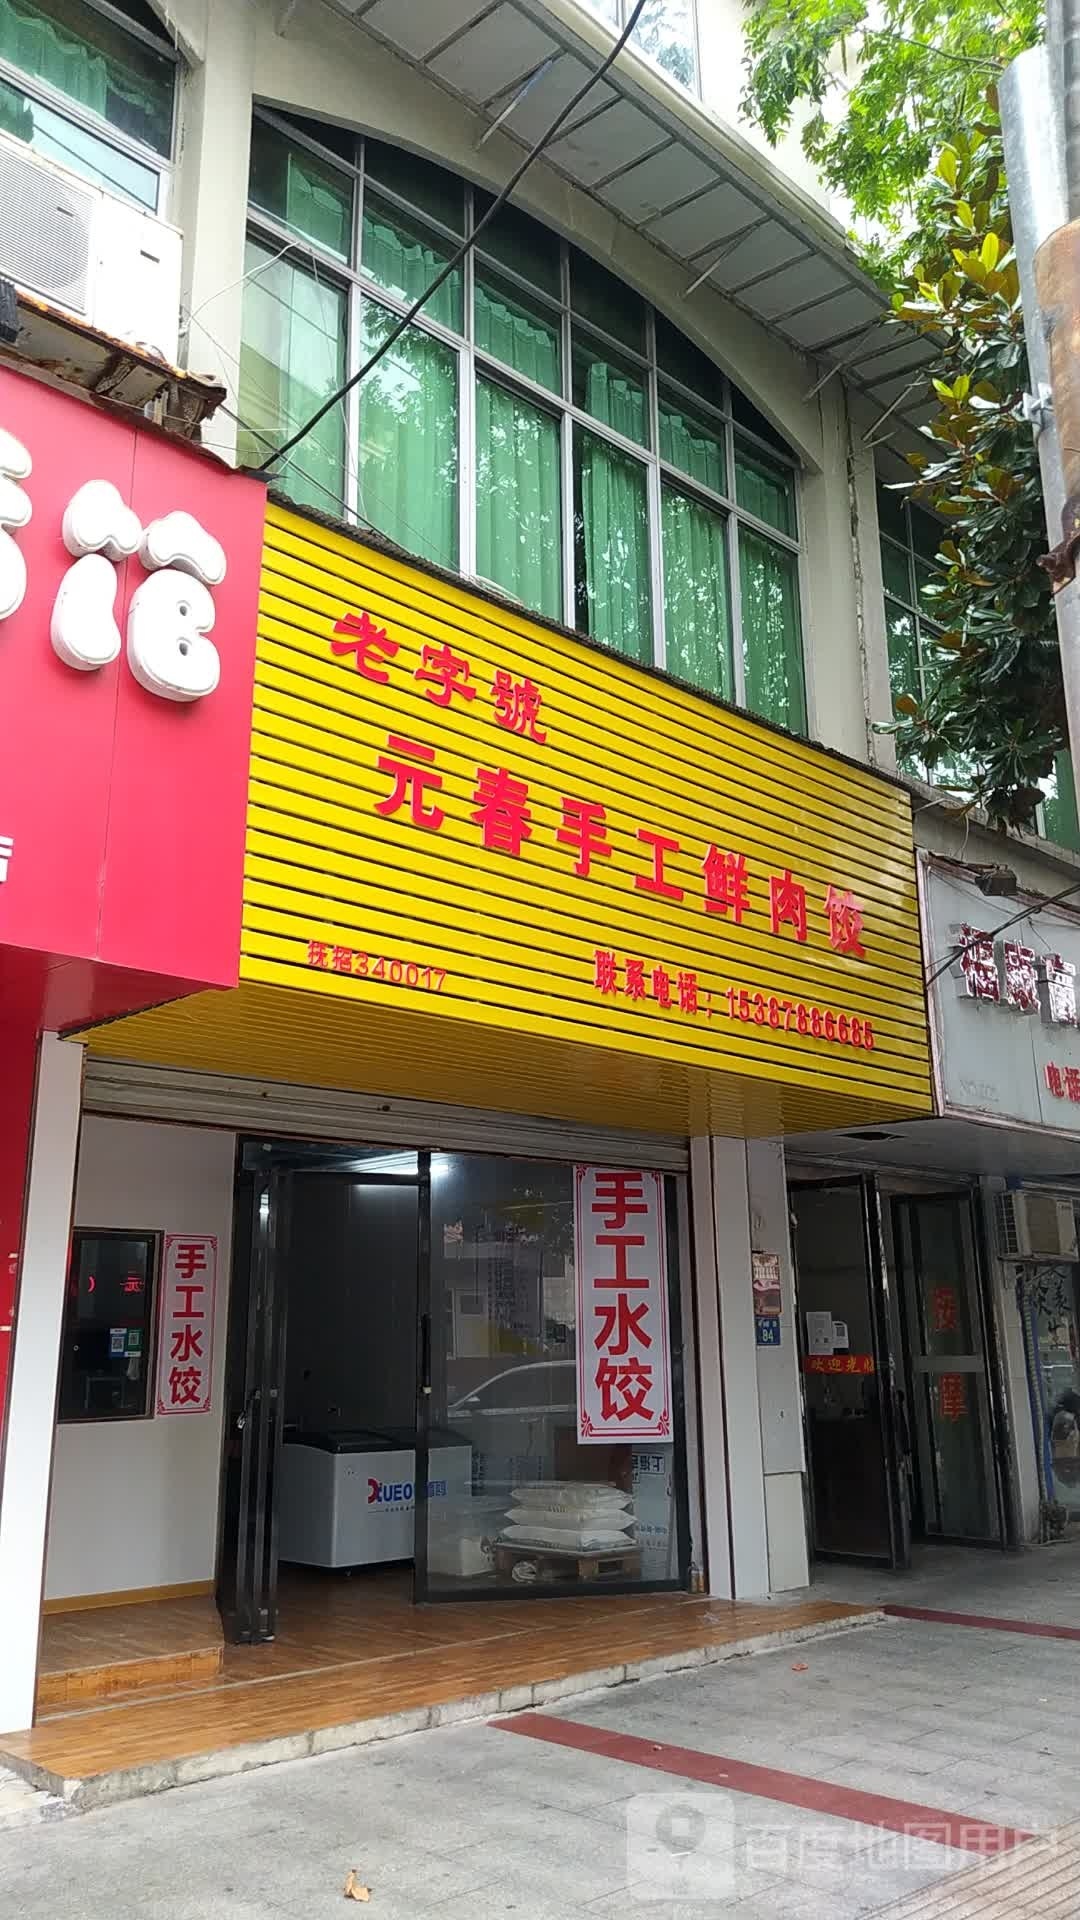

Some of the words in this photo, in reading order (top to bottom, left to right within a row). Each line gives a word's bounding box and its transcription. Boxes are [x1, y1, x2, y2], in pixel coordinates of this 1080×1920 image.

[330, 611, 547, 744] 老字號
[374, 735, 866, 958] 元春手工鲜肉饺
[169, 1244, 207, 1405] 手工水饺
[591, 1172, 655, 1422] 手工水饺
